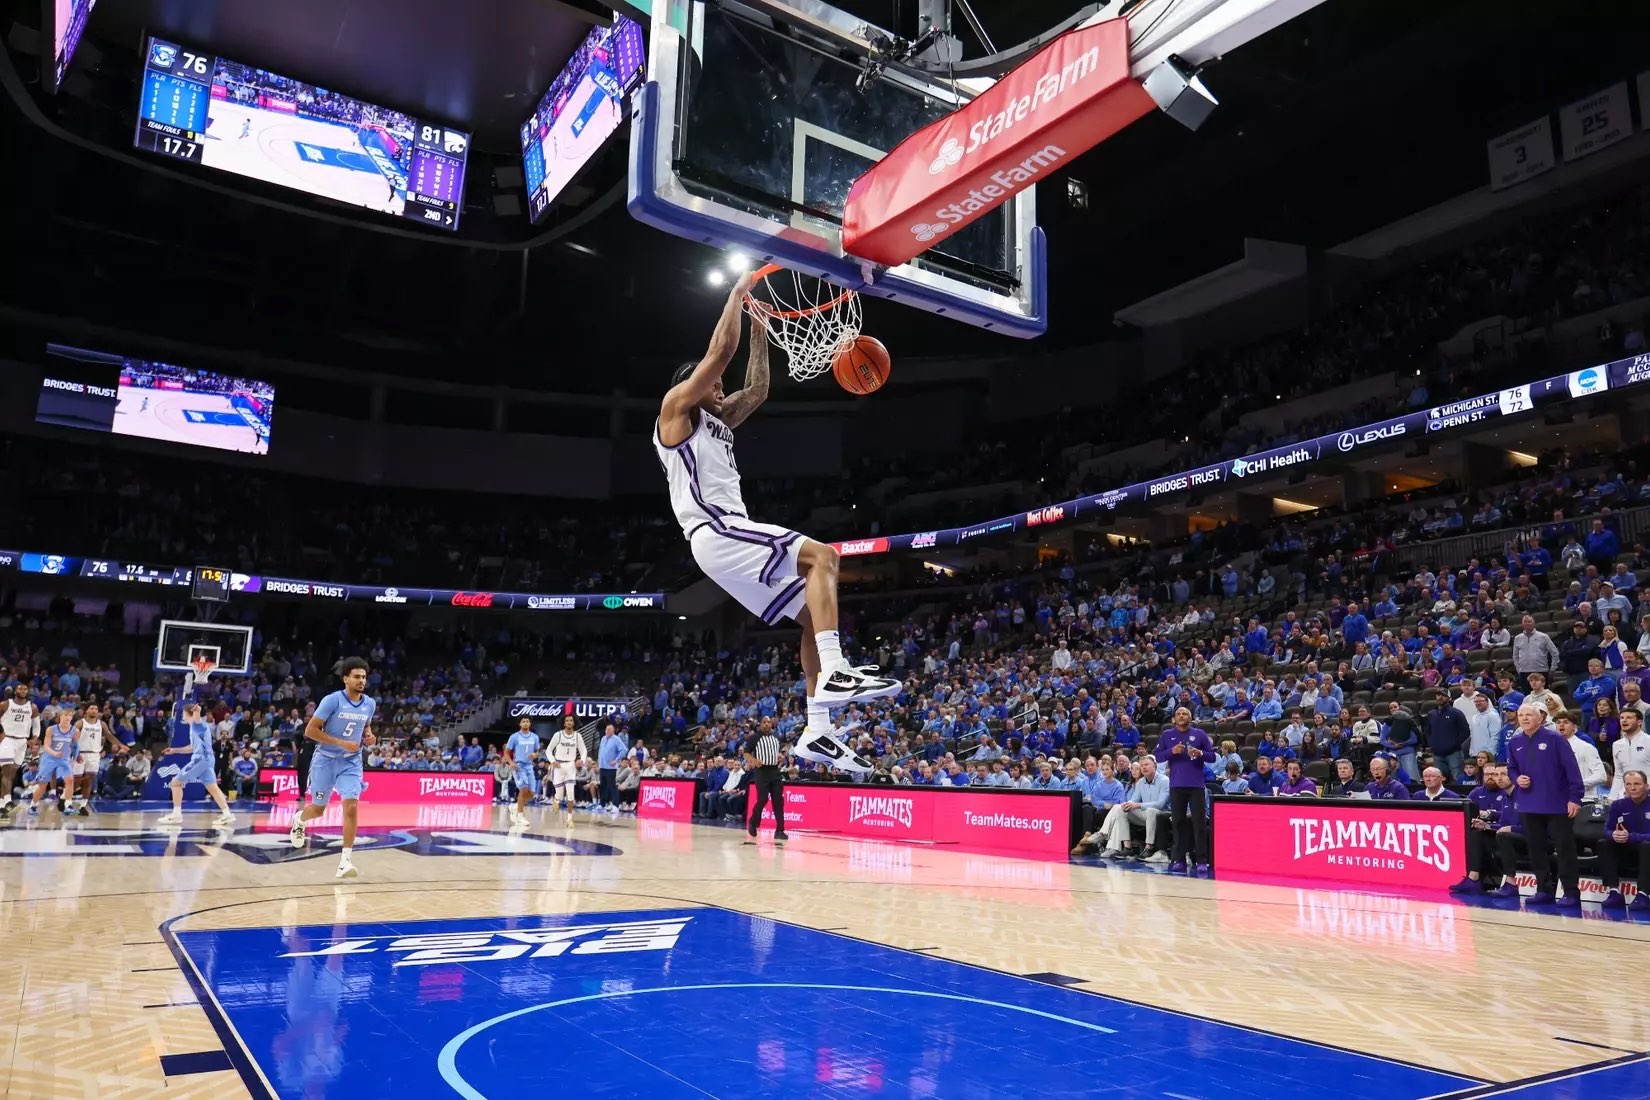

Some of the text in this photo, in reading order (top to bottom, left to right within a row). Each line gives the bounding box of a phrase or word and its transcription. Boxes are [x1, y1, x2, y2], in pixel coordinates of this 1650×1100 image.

[182, 52, 207, 74] 76
[171, 78, 186, 87] PTS
[188, 83, 202, 92] FLS
[966, 46, 1098, 154] State Farm
[148, 121, 163, 130] TEAM
[163, 124, 182, 135] FOULS
[422, 126, 441, 144] 81
[164, 137, 196, 158] 17.7
[1514, 145, 1527, 164] 3
[936, 144, 1066, 224] State Farm
[424, 208, 441, 221] 2ND
[44, 378, 116, 398] BRIDGES TRUST
[1546, 381, 1552, 390] F
[1442, 388, 1522, 416] MICHIGAN ST. 76
[1444, 401, 1522, 428] PENN ST. 72
[1355, 423, 1406, 445] LEXUS
[1247, 448, 1310, 474] CHI Health
[1150, 468, 1220, 496] BRIDGES TRUST
[841, 540, 876, 554] Baxter
[92, 562, 108, 572] 76
[266, 581, 343, 598] BRIDGES TRUST
[624, 598, 652, 606] OWEN
[511, 703, 564, 717] Michelob
[342, 722, 357, 737] 5
[420, 778, 486, 796] TEAMMATES
[786, 790, 806, 802] Team.
[642, 786, 676, 808] TEAMMATES
[784, 811, 803, 822] entor.
[849, 796, 912, 828] TEAMMATES
[863, 818, 894, 828] MENTORING
[964, 810, 1052, 834] TeamMates.org
[1289, 817, 1450, 872] TEAMMATES
[1327, 854, 1405, 870] MENTORING
